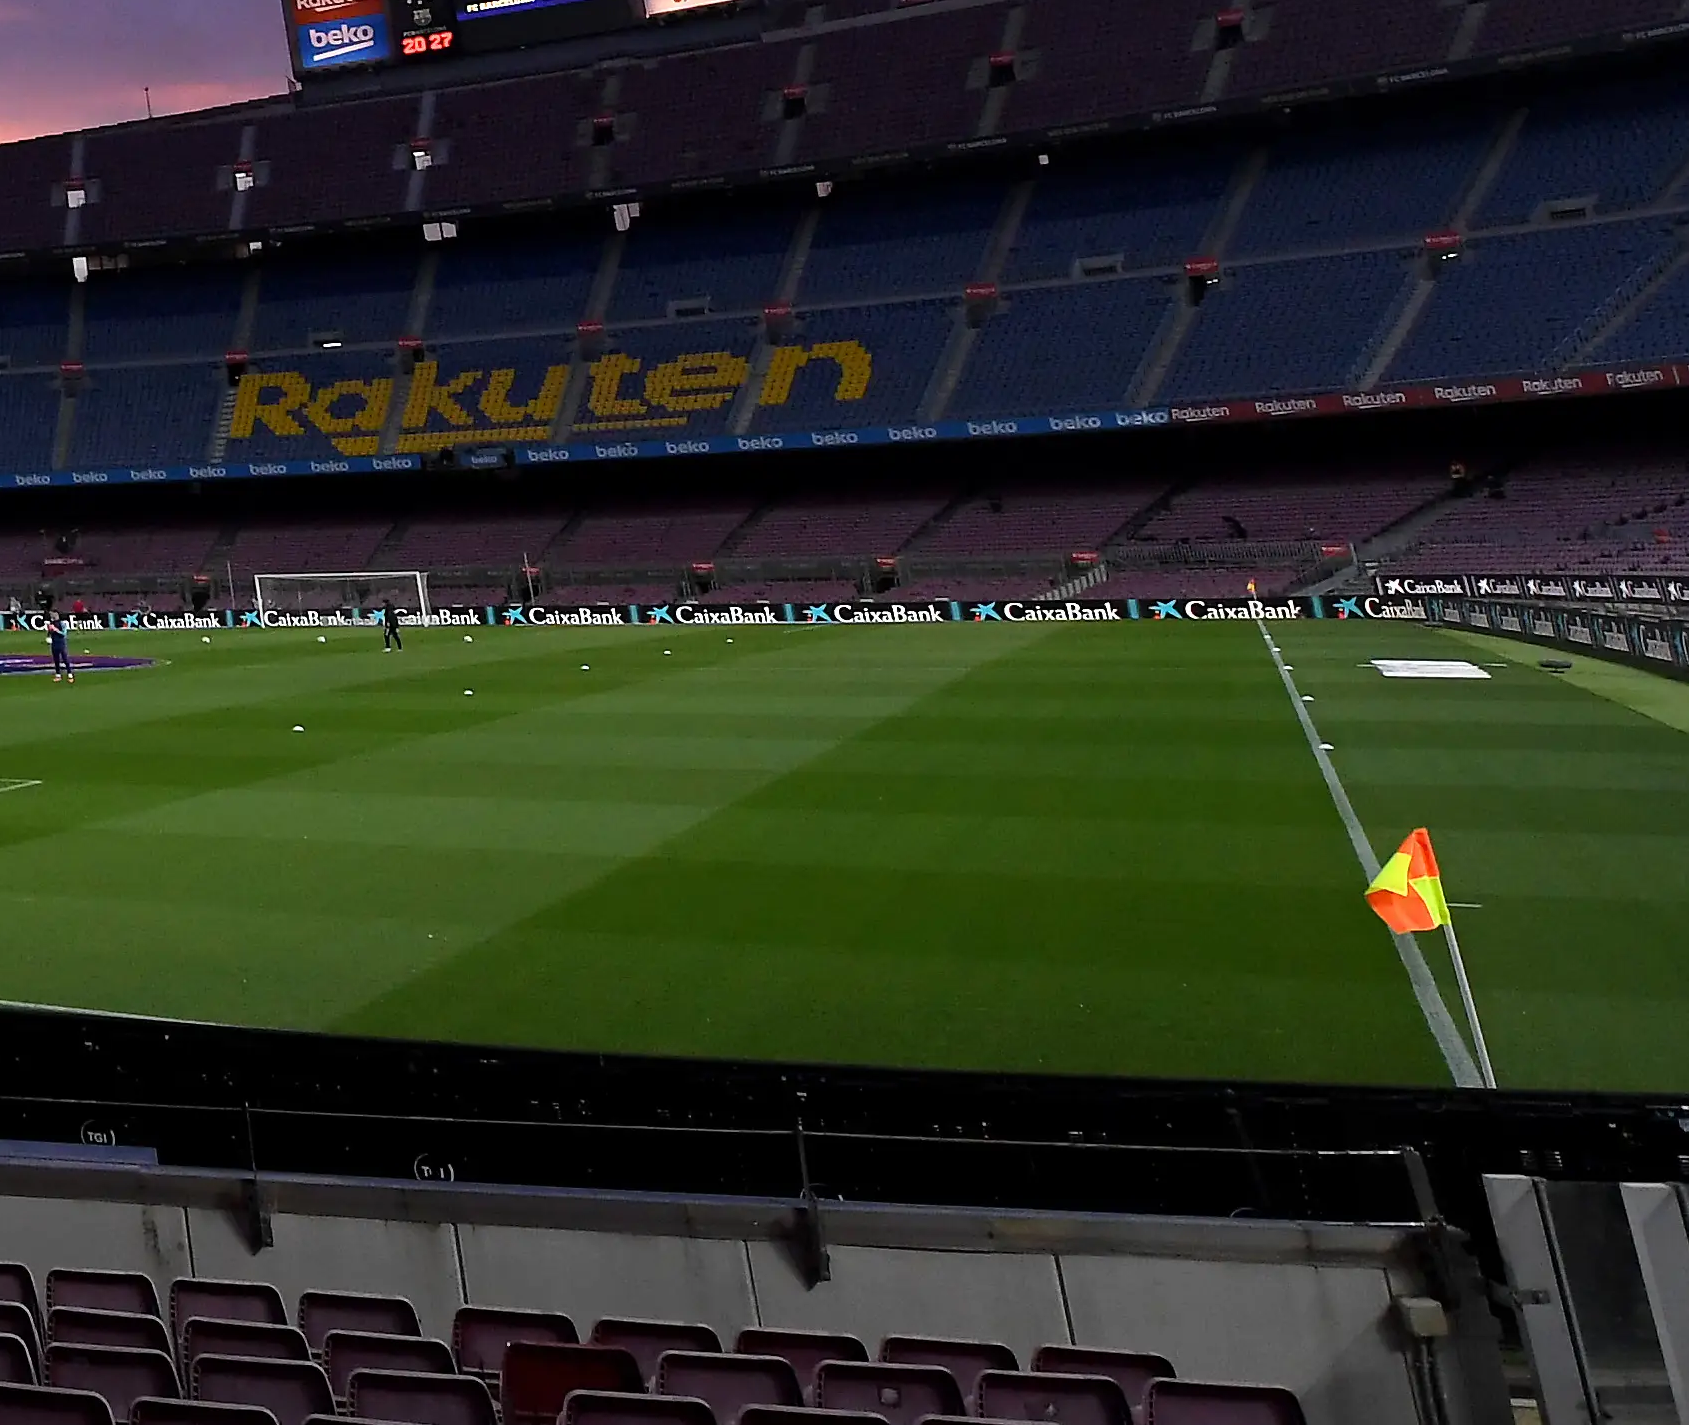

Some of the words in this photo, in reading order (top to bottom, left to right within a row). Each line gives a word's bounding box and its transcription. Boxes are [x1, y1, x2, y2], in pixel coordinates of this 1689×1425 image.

[309, 24, 373, 48] beko
[402, 37, 427, 55] 20
[429, 32, 453, 50] 27
[1523, 377, 1583, 393] Rakuten
[1606, 368, 1664, 387] Rakuten
[230, 340, 872, 439] Rakuten
[1434, 383, 1497, 401] Rakuten
[1255, 398, 1317, 414] Rakuten
[1342, 391, 1407, 408] Rakuten
[1115, 411, 1169, 427] beko
[1171, 405, 1231, 421] Rakuten
[967, 419, 1018, 436] beko
[1049, 416, 1102, 432] beko
[811, 430, 859, 445] beko
[888, 425, 937, 441] beko
[595, 444, 639, 458] beko
[666, 441, 710, 455] beko
[738, 437, 784, 451] beko
[471, 455, 498, 464] beko
[527, 448, 570, 462] beko
[249, 463, 287, 476] beko
[311, 460, 349, 473] beko
[373, 457, 412, 471] beko
[15, 474, 51, 486] beko
[72, 472, 108, 484] beko
[131, 469, 167, 481] beko
[189, 466, 226, 479] beko
[1403, 578, 1465, 594] CaixaBank
[529, 607, 625, 625] CaixaBank
[675, 606, 779, 624] CaixaBank
[833, 604, 944, 623] CaixaBank
[1004, 602, 1121, 620] CaixaBank
[1185, 600, 1302, 619] CaixaBank
[143, 613, 221, 629] CaixaBank
[87, 1131, 107, 1144] TGI
